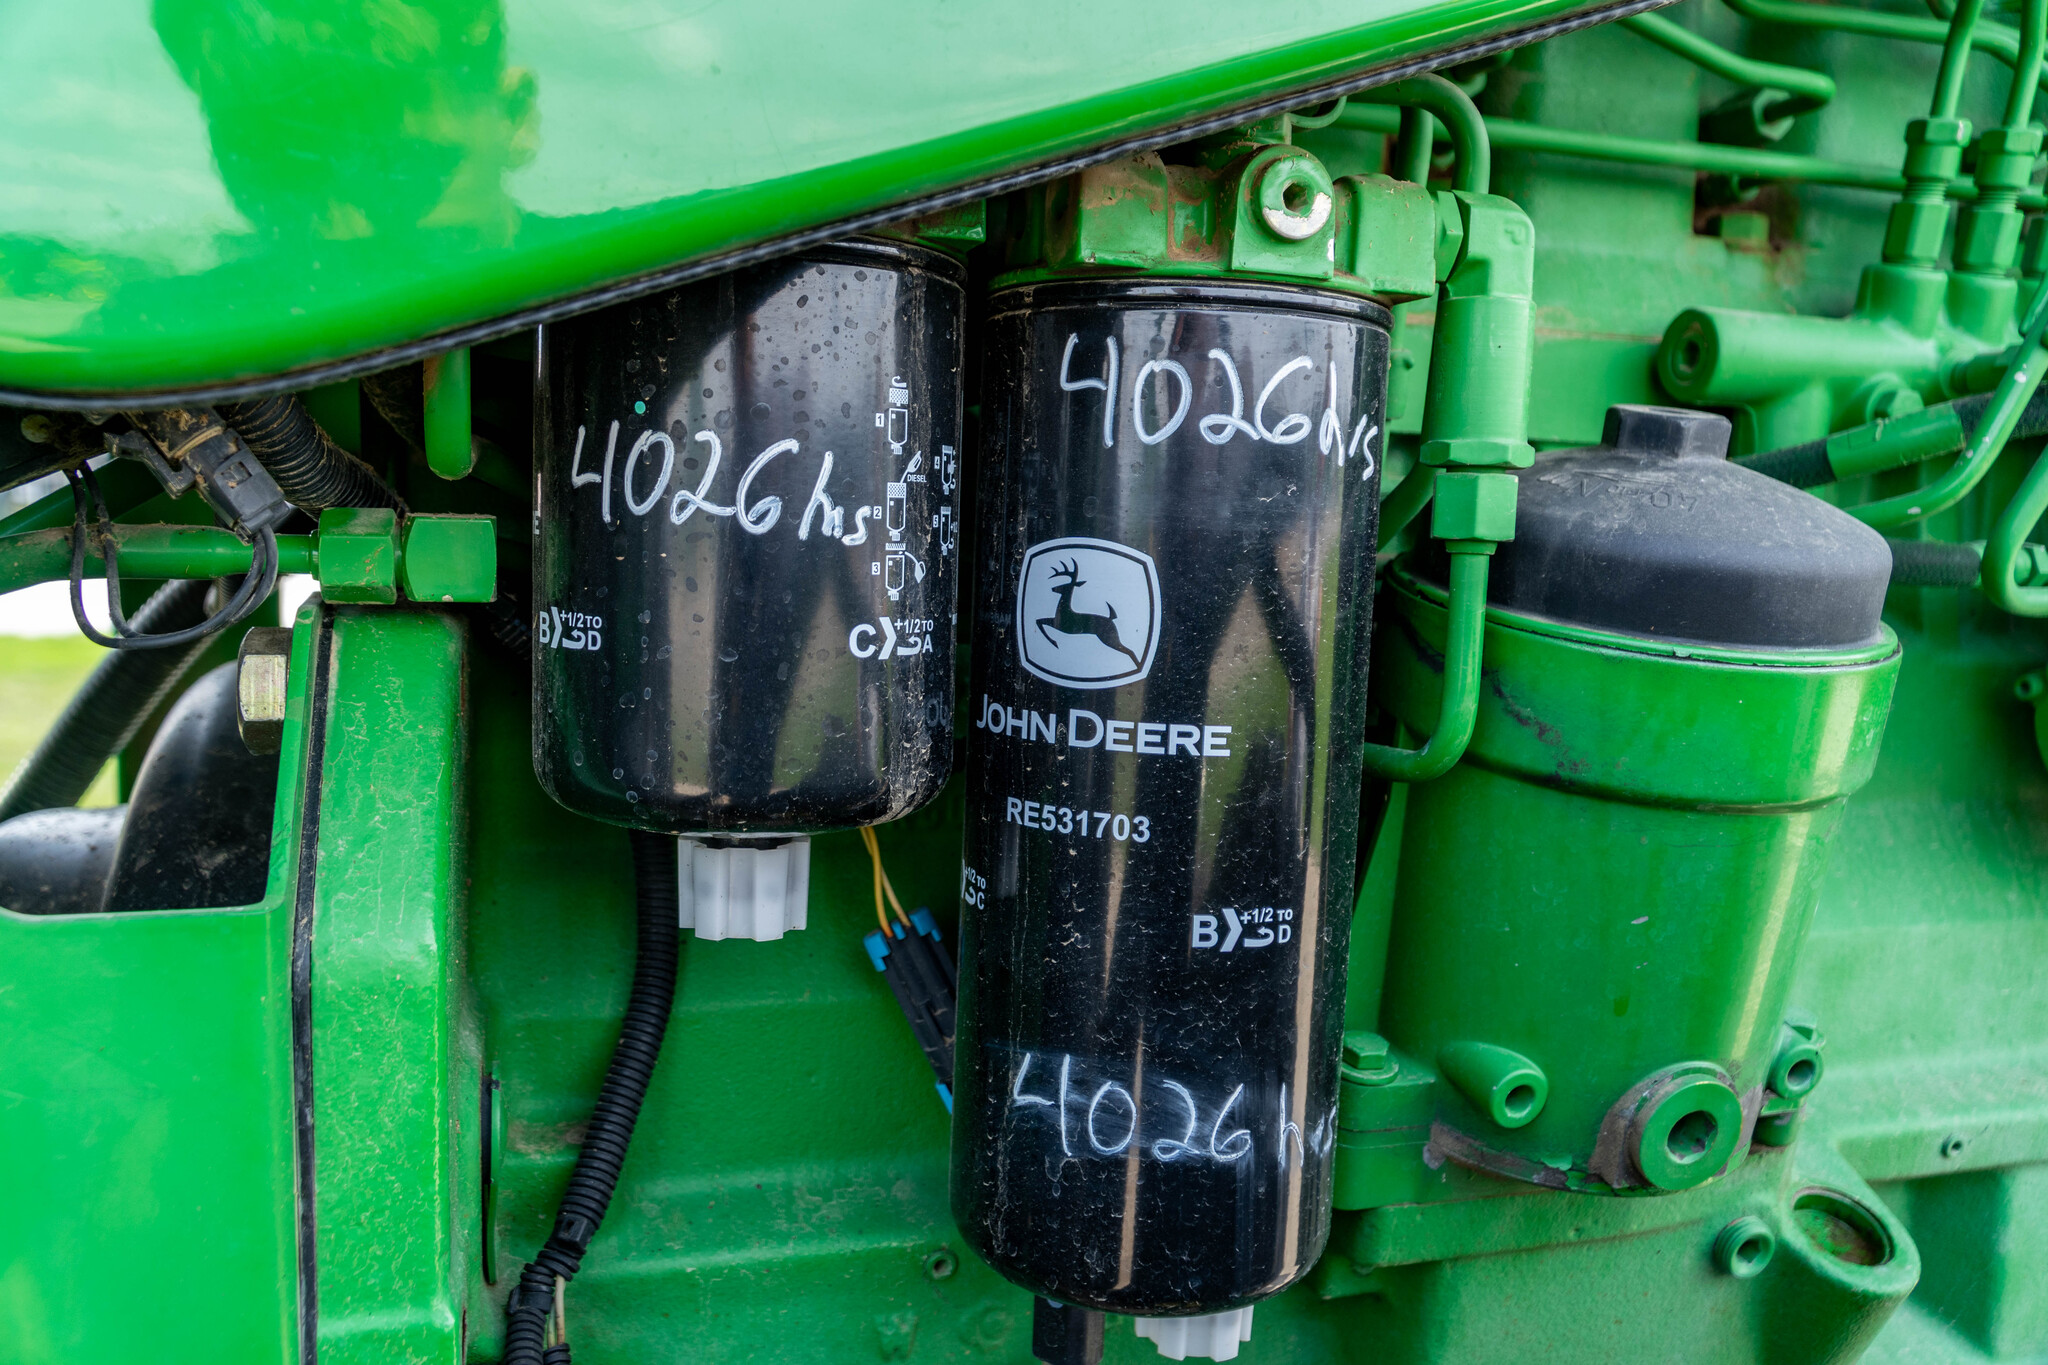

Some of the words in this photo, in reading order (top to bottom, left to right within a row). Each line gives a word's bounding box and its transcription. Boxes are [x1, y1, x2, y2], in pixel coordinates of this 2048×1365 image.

[1060, 333, 1312, 447] 4026
[572, 420, 800, 535] 4026
[907, 474, 927, 483] DIESEL
[539, 611, 550, 644] B
[585, 616, 603, 629] TO
[922, 620, 934, 632] TO
[587, 631, 601, 651] D
[849, 623, 877, 659] C
[922, 634, 933, 654] A
[976, 694, 1056, 744] JOHN
[1068, 709, 1232, 757] DEERE
[1006, 797, 1150, 843] RE531703
[976, 875, 986, 889] TO
[1276, 909, 1294, 922] TO
[1192, 914, 1219, 948] B
[1278, 924, 1292, 944] D
[1013, 1053, 1252, 1162] 4026
